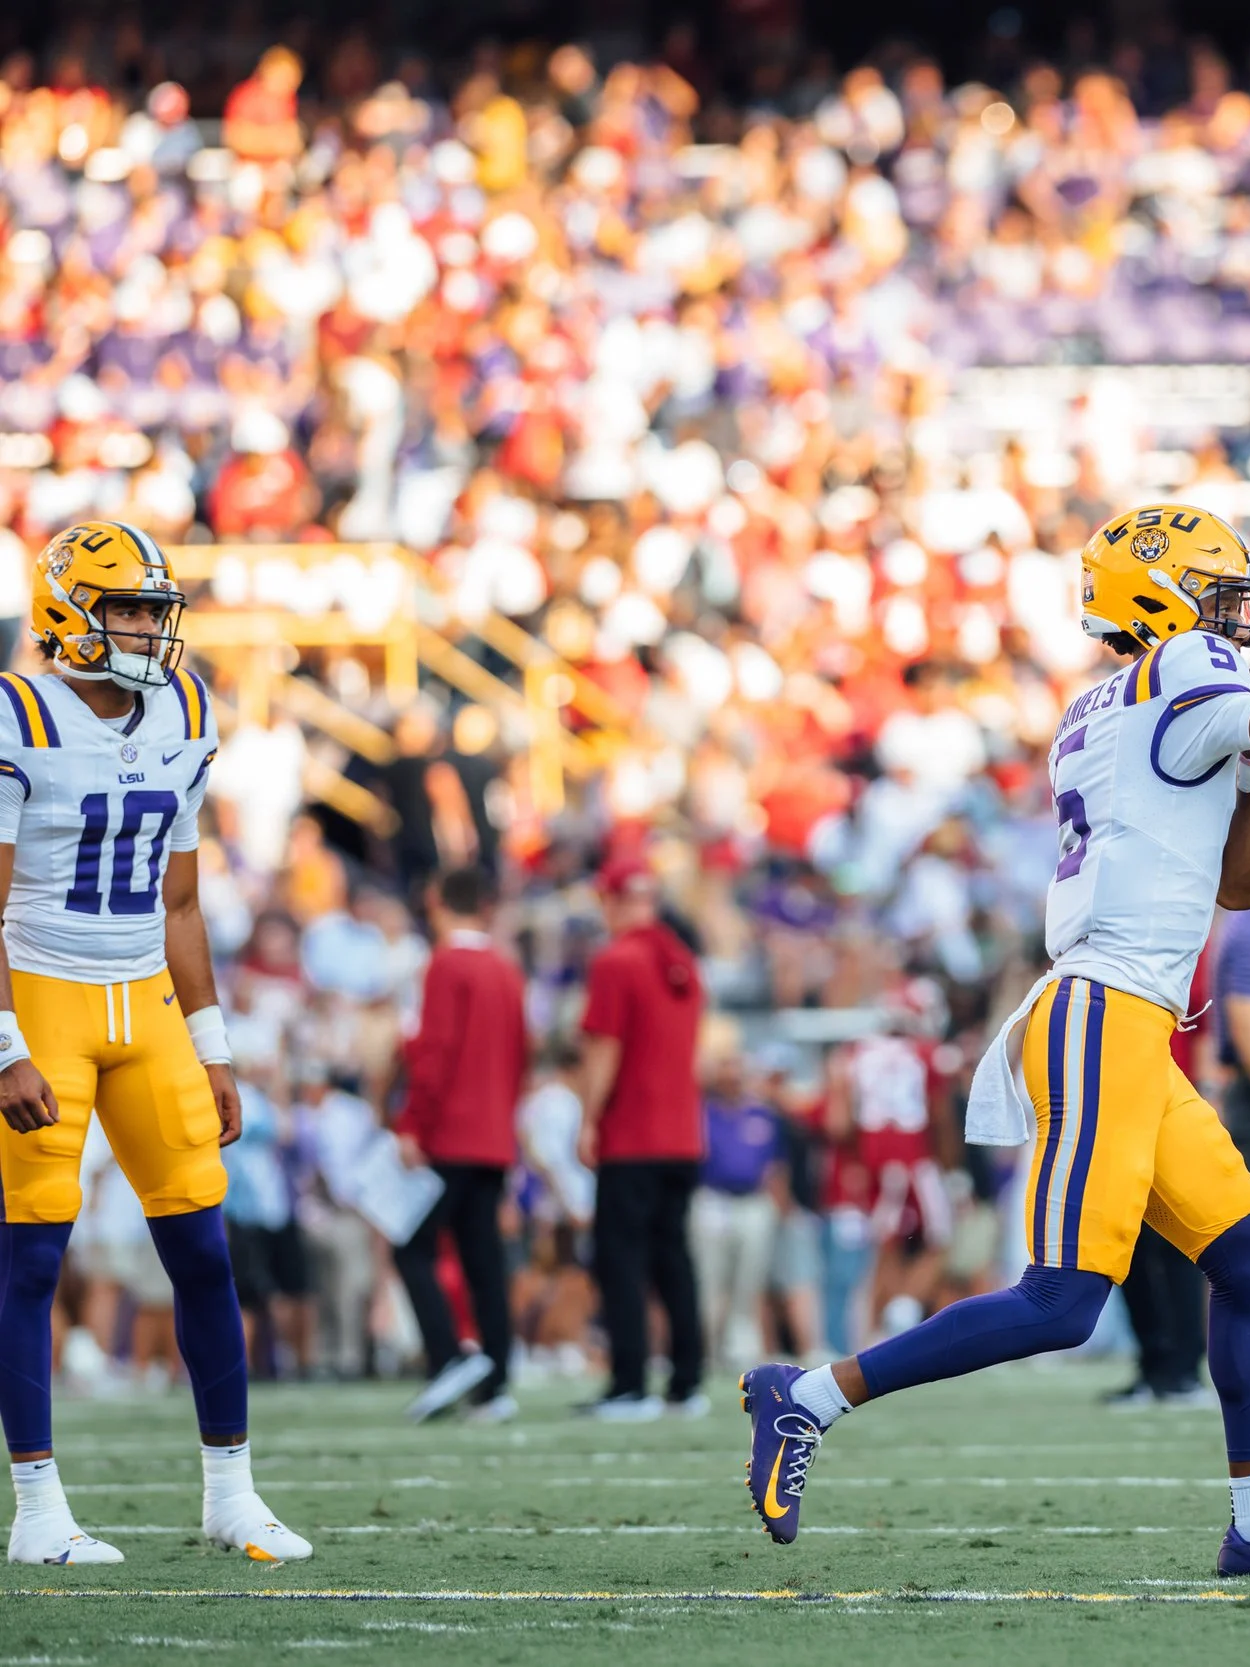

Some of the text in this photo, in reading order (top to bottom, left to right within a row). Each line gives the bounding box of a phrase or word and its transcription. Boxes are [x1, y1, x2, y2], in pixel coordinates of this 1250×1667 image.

[60, 526, 114, 553] SU
[1103, 509, 1202, 546] LSU
[1203, 635, 1237, 672] 5
[118, 772, 145, 784] LSU
[1054, 724, 1092, 883] 5
[65, 790, 179, 915] 10
